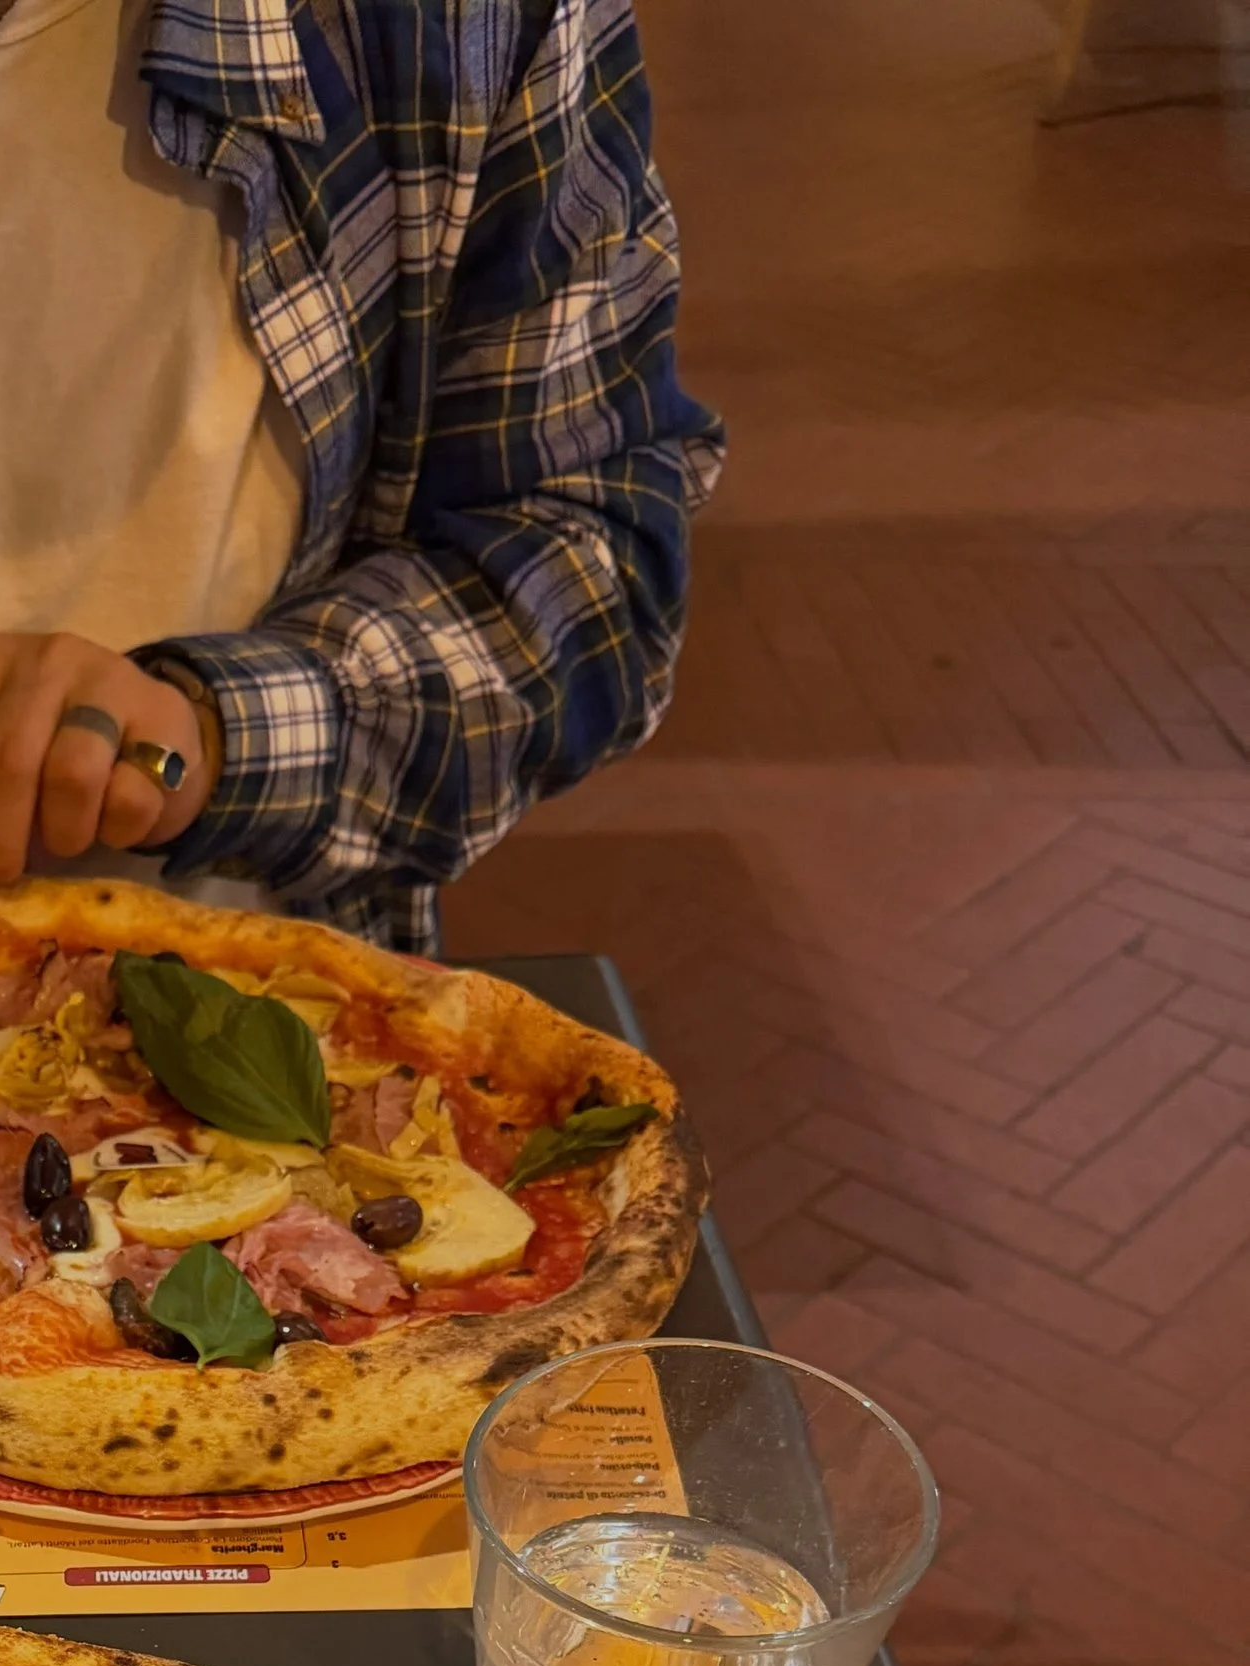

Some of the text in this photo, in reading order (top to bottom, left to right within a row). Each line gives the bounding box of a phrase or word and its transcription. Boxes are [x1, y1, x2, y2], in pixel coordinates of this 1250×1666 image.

[211, 1543, 284, 1553] Margherita
[95, 1568, 248, 1582] PIZZE TRADIZIONALI
